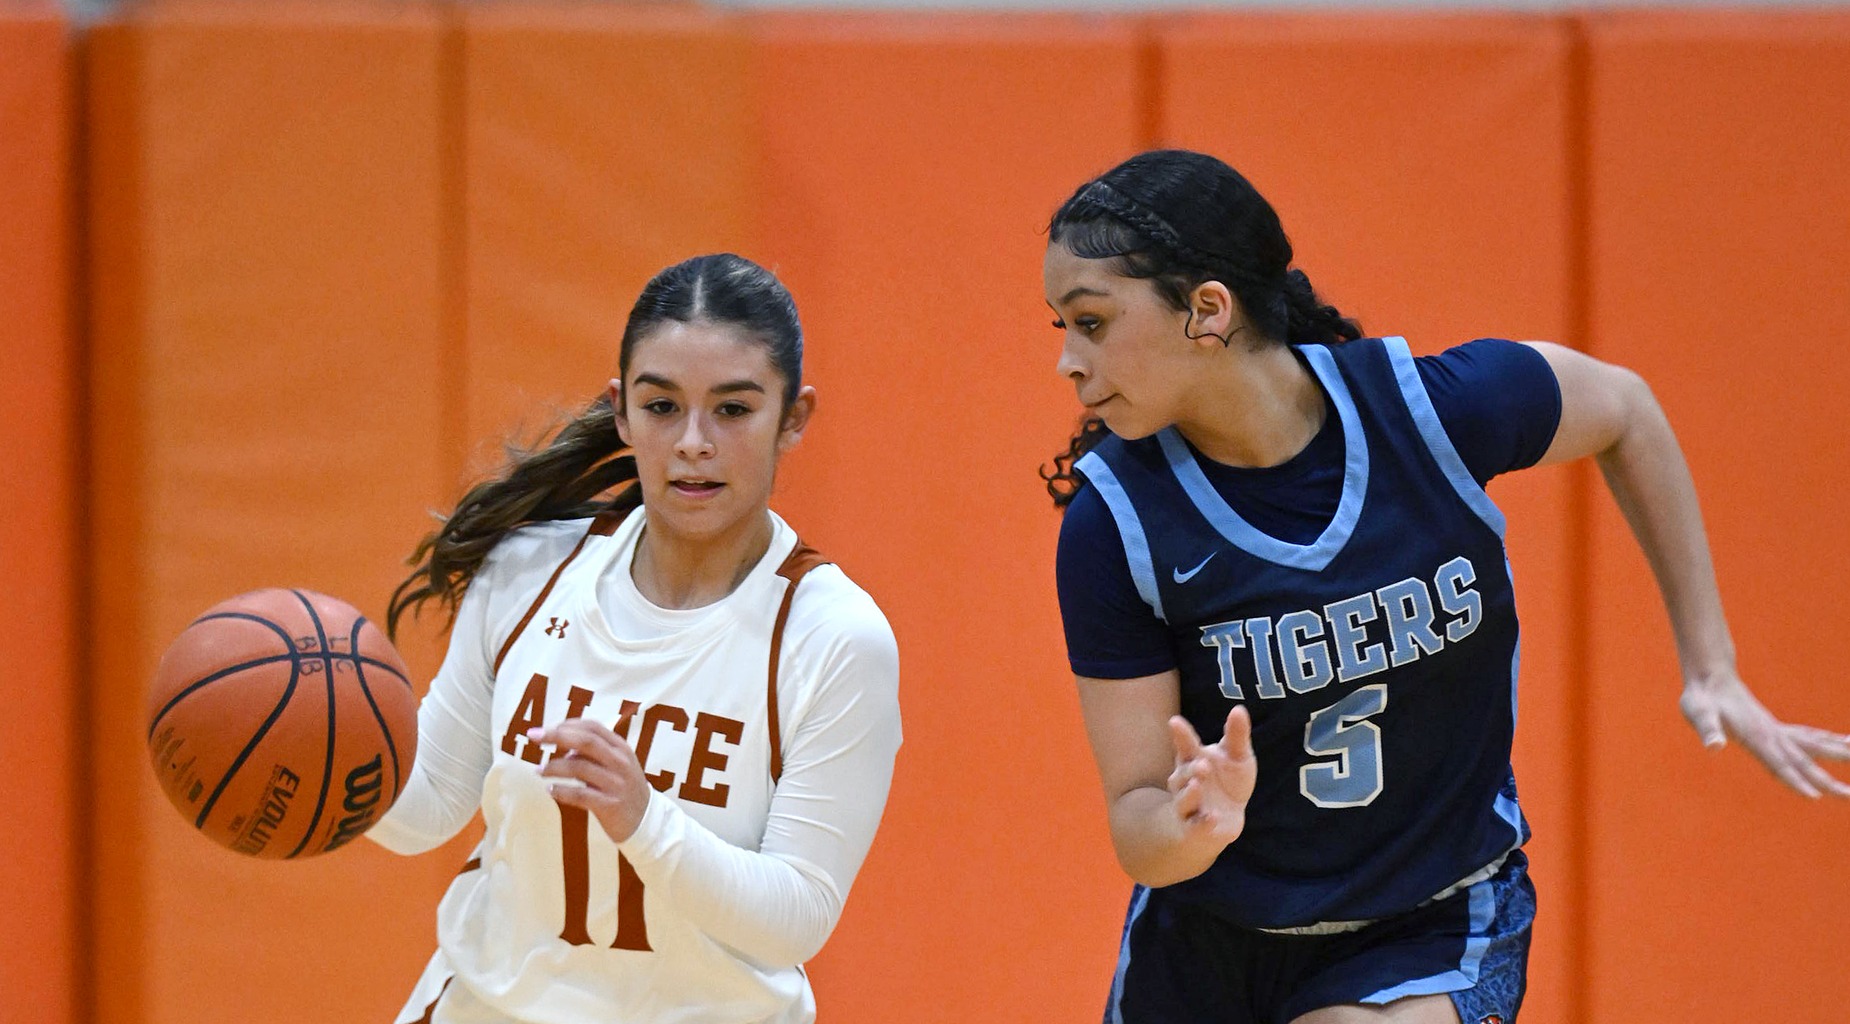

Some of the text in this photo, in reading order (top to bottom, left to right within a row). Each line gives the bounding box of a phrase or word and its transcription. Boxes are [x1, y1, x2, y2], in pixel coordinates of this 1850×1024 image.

[1199, 556, 1482, 700] TIGERS
[249, 767, 300, 855] EVOLU
[1300, 683, 1387, 808] 5
[555, 798, 654, 952] 11
